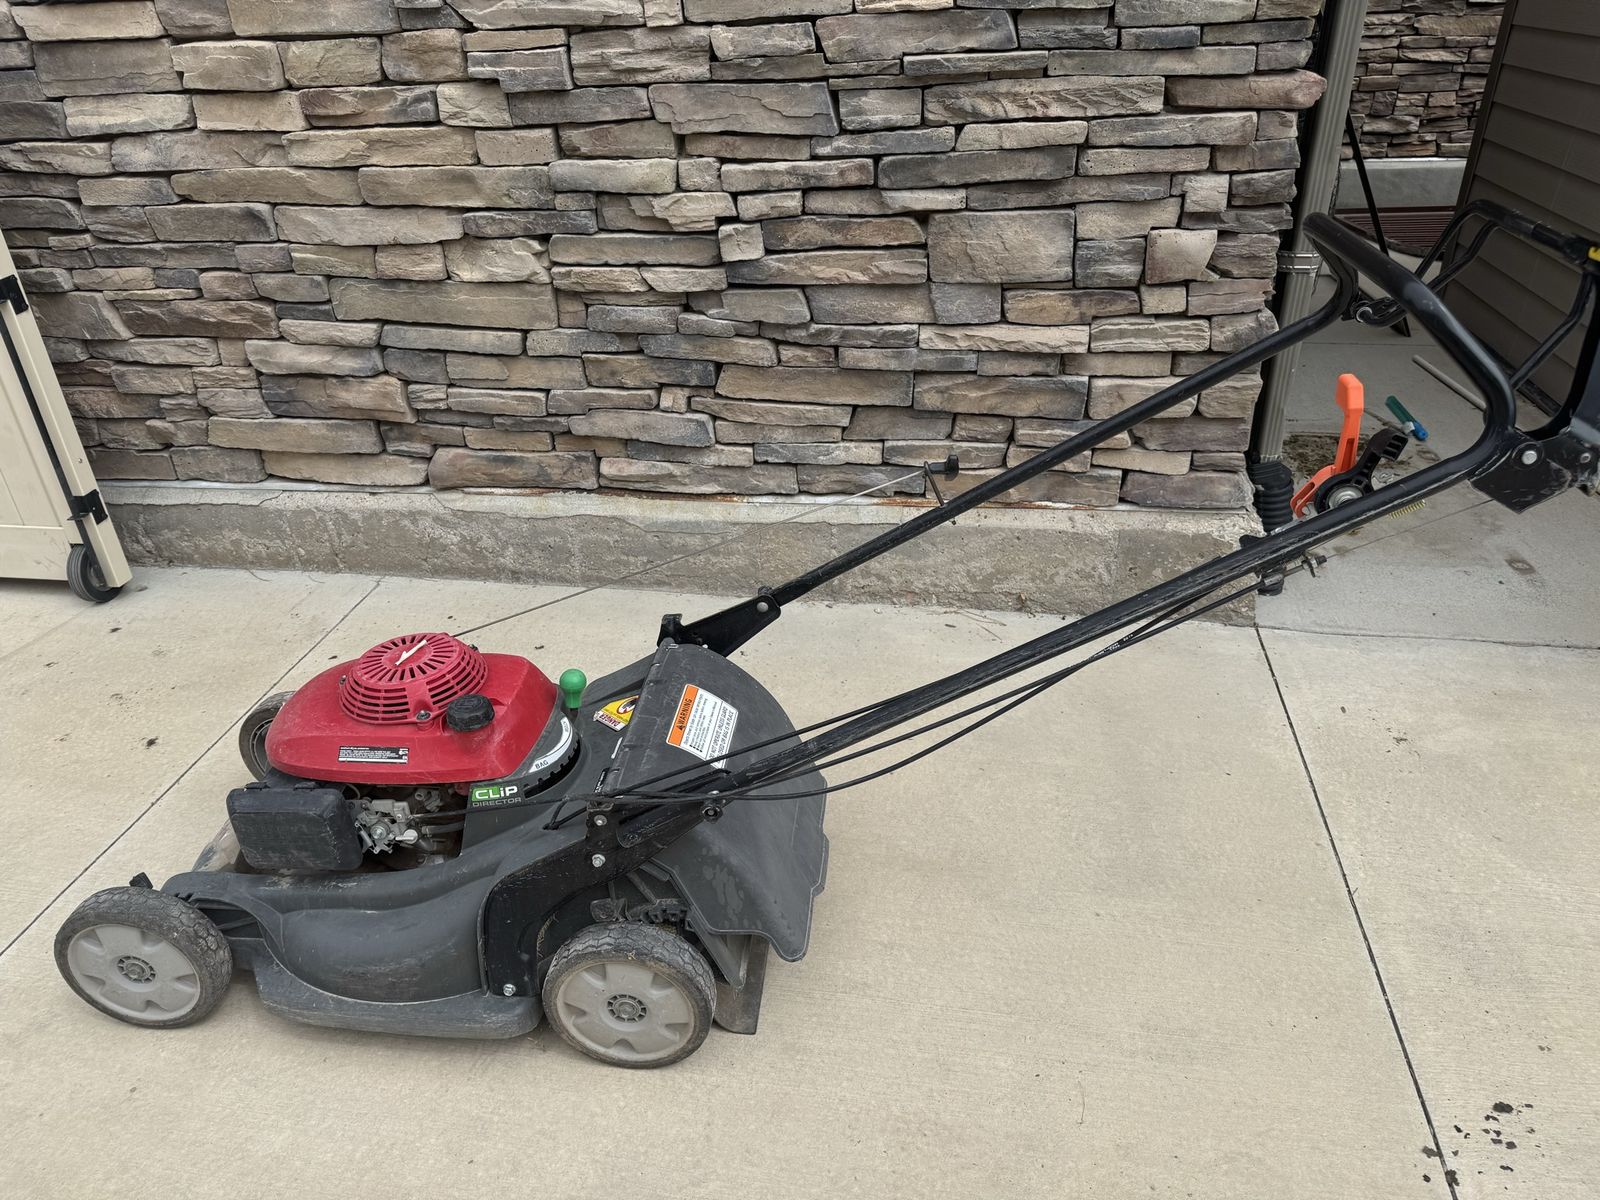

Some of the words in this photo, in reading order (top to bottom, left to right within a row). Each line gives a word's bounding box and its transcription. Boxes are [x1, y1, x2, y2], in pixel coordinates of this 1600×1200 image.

[678, 698, 693, 726] WARNING
[534, 759, 549, 770] BAG
[472, 797, 522, 807] DIRECTOR
